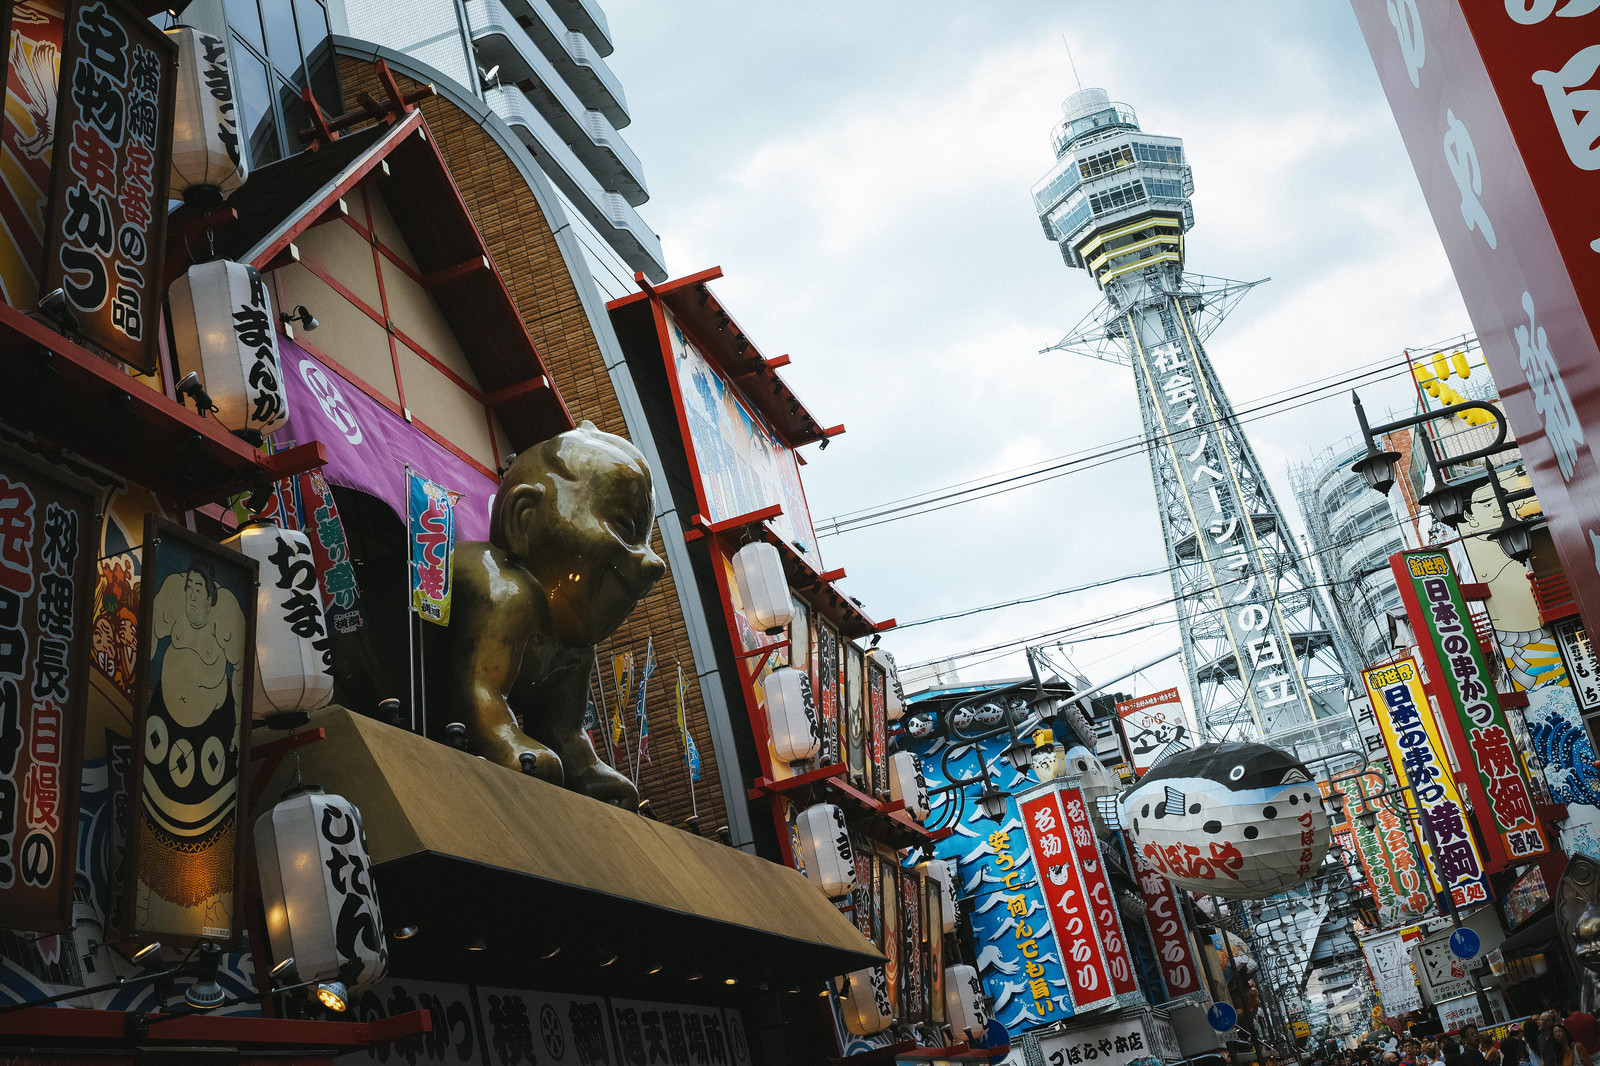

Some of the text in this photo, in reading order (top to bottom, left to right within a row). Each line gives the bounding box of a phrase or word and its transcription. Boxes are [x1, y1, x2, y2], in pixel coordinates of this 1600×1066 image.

[61, 3, 129, 313] 名物串かつ
[112, 44, 161, 341] 横綱定番の一品
[416, 498, 448, 600] どて焼
[1151, 343, 1298, 709] 社会イノベーションの日立
[1407, 555, 1449, 578] 新世界
[20, 501, 79, 889] 料理長自慢の
[1369, 663, 1414, 690] 新世界
[1423, 578, 1494, 727] 日本一の串かつ
[1384, 684, 1447, 808] 日本一の串かつ
[1471, 726, 1536, 829] 横綱
[1067, 799, 1129, 982] 名物 てっちり
[1142, 841, 1244, 880] づぼらや
[1296, 809, 1316, 878] づぼらや
[1418, 800, 1482, 885] 横綱
[1507, 828, 1544, 854] 酒処
[988, 830, 1054, 1016] 安うて何んでも旨い
[1034, 807, 1098, 991] 名物 てっちり
[1449, 881, 1487, 907] 酒処
[487, 994, 608, 1066] 横綱
[1049, 1031, 1144, 1066] づぼらや本店
